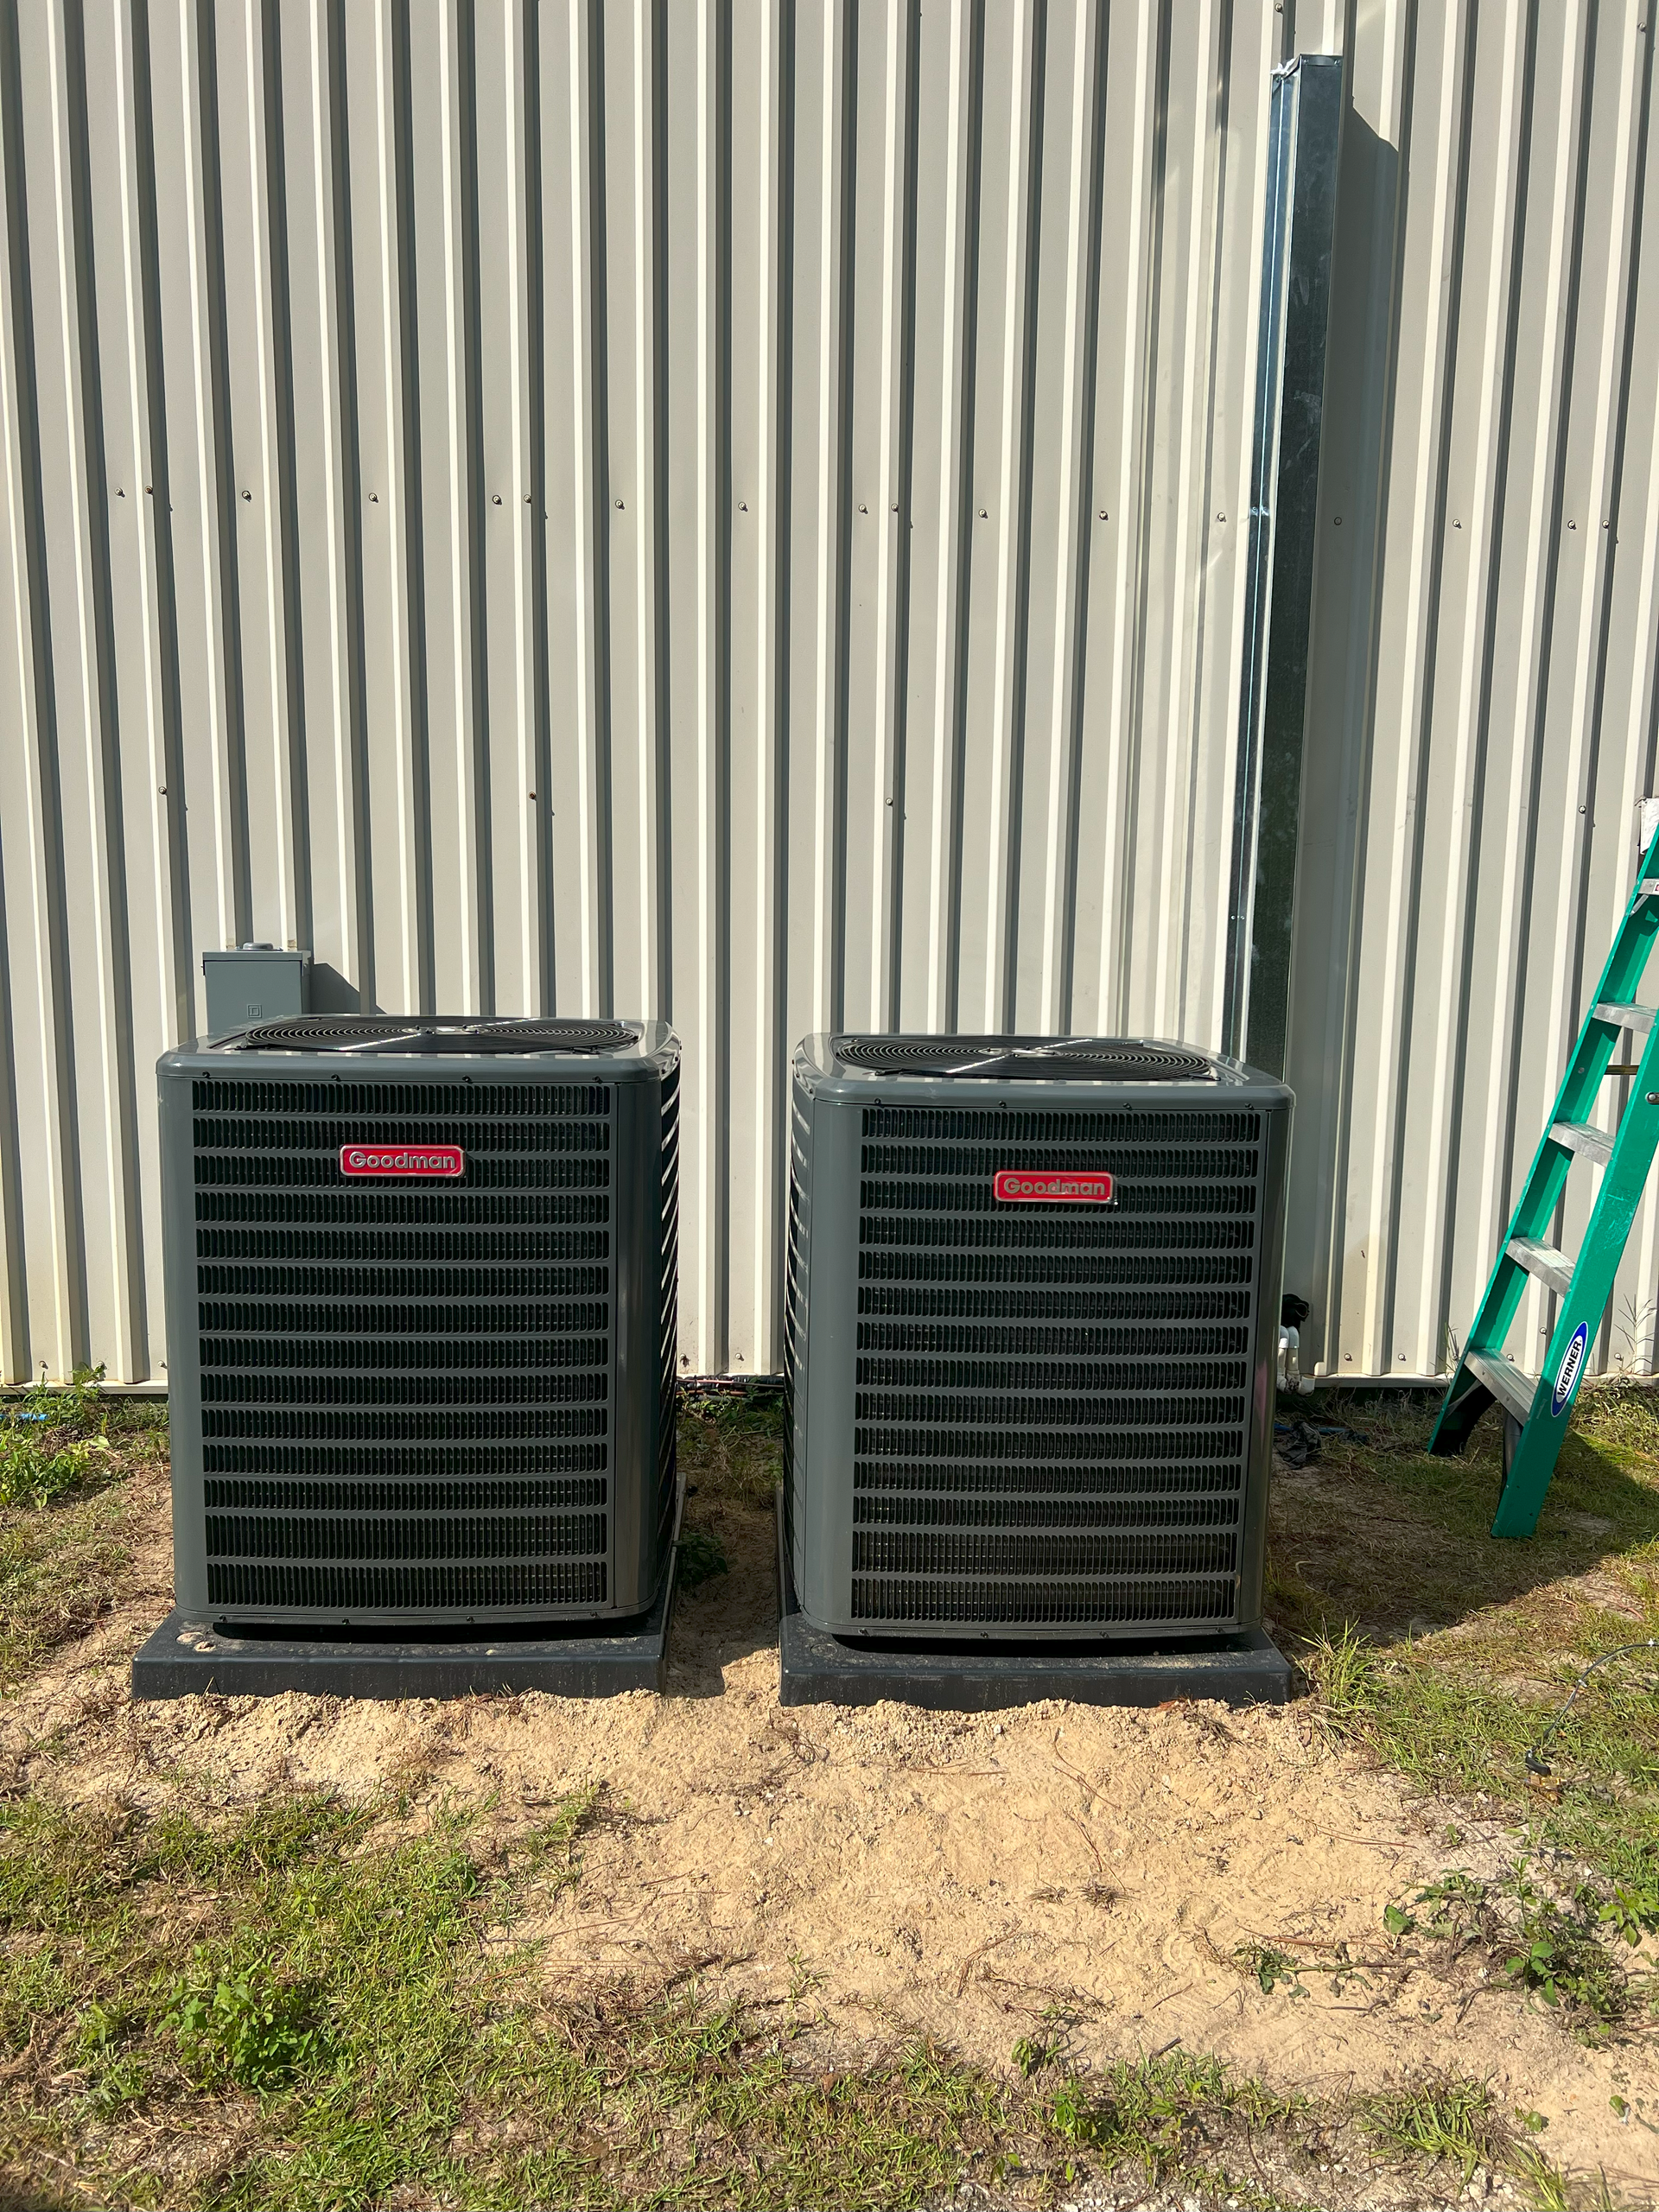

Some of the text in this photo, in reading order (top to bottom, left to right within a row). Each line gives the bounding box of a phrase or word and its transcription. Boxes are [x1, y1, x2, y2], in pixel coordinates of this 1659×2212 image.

[348, 1151, 455, 1170] Goodman
[1003, 1177, 1105, 1196] Goodman
[1557, 1338, 1582, 1397] WERNER
